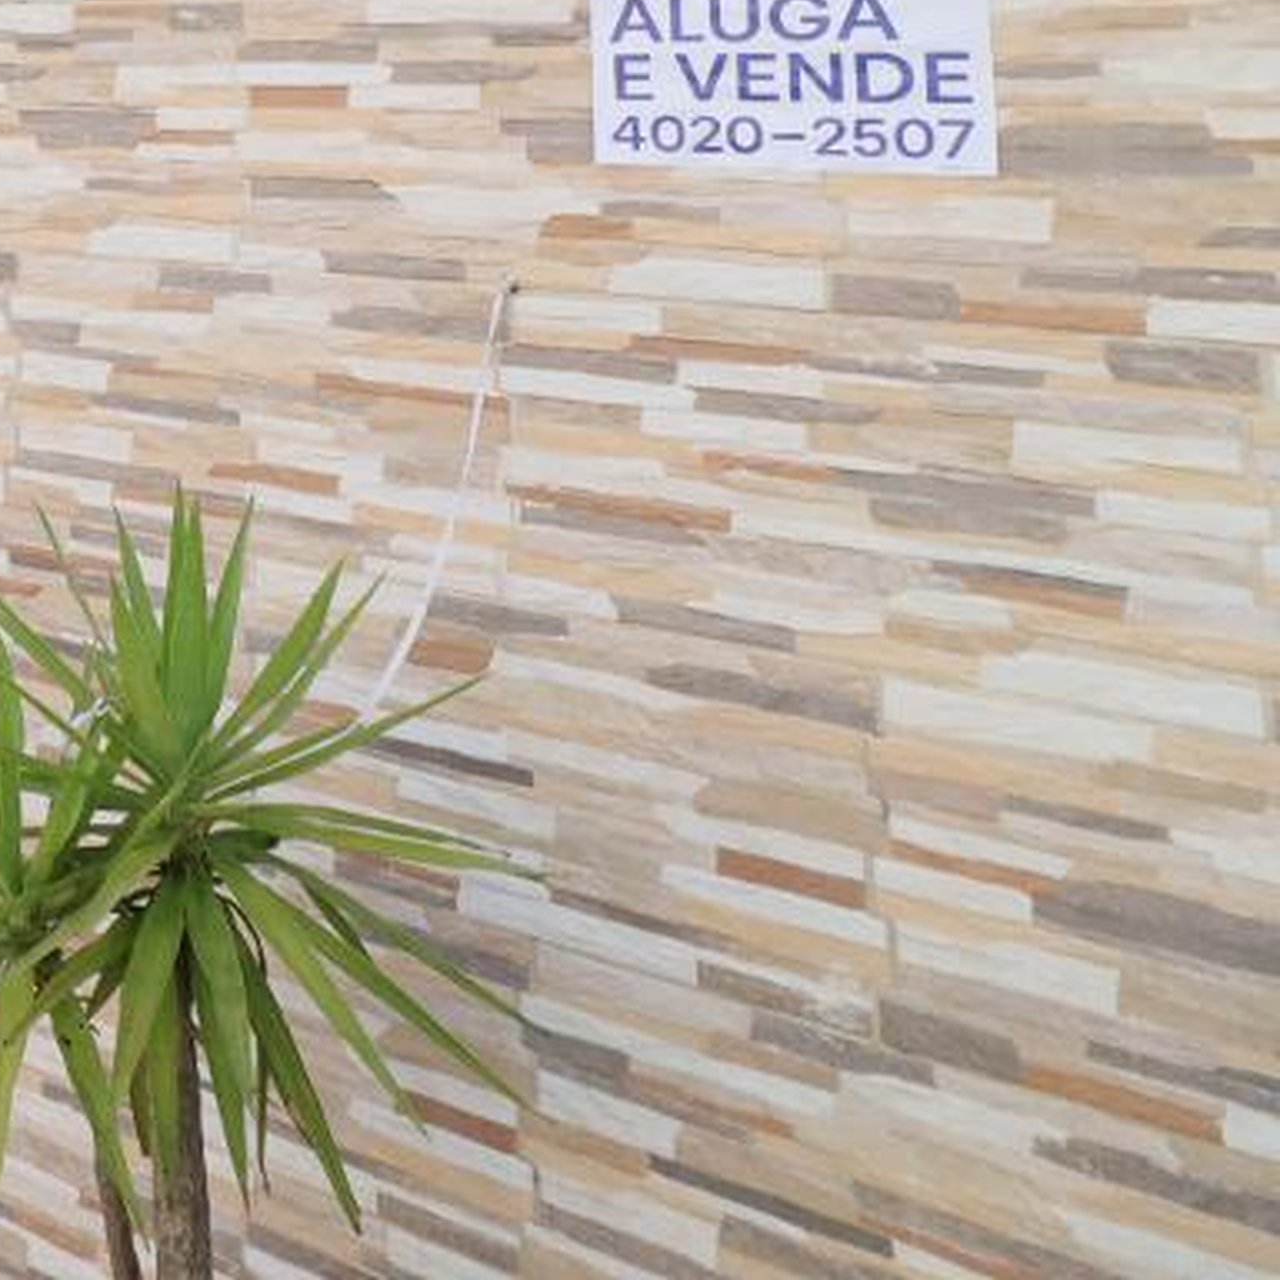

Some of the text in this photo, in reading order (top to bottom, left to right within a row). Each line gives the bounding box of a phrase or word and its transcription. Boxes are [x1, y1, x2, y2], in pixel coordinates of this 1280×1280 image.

[613, 51, 975, 105] E VENDE
[611, 113, 976, 160] 4020-2507
